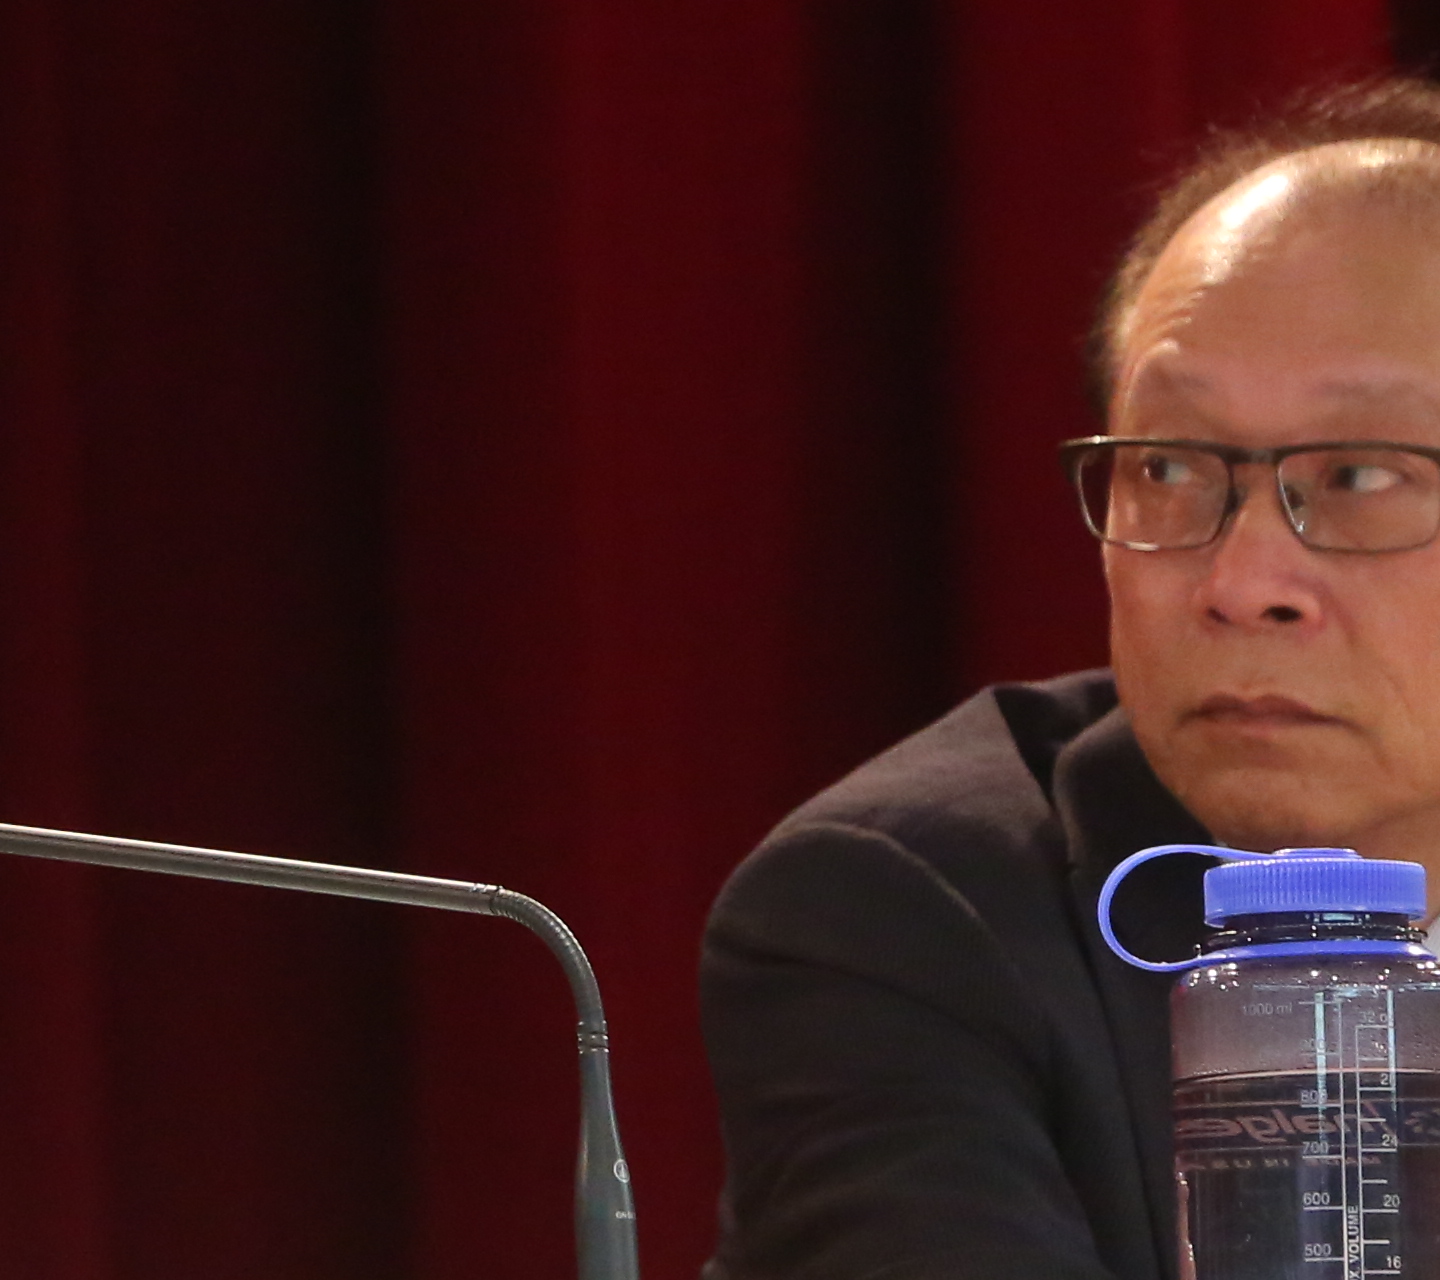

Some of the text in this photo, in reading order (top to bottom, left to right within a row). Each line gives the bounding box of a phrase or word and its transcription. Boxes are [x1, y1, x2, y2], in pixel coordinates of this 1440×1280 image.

[1302, 1141, 1329, 1154] 700
[1303, 1192, 1330, 1206] 600
[1383, 1194, 1400, 1208] 20
[1347, 1205, 1360, 1264] VOLUME
[1304, 1243, 1332, 1257] 500
[1386, 1255, 1402, 1269] 16
